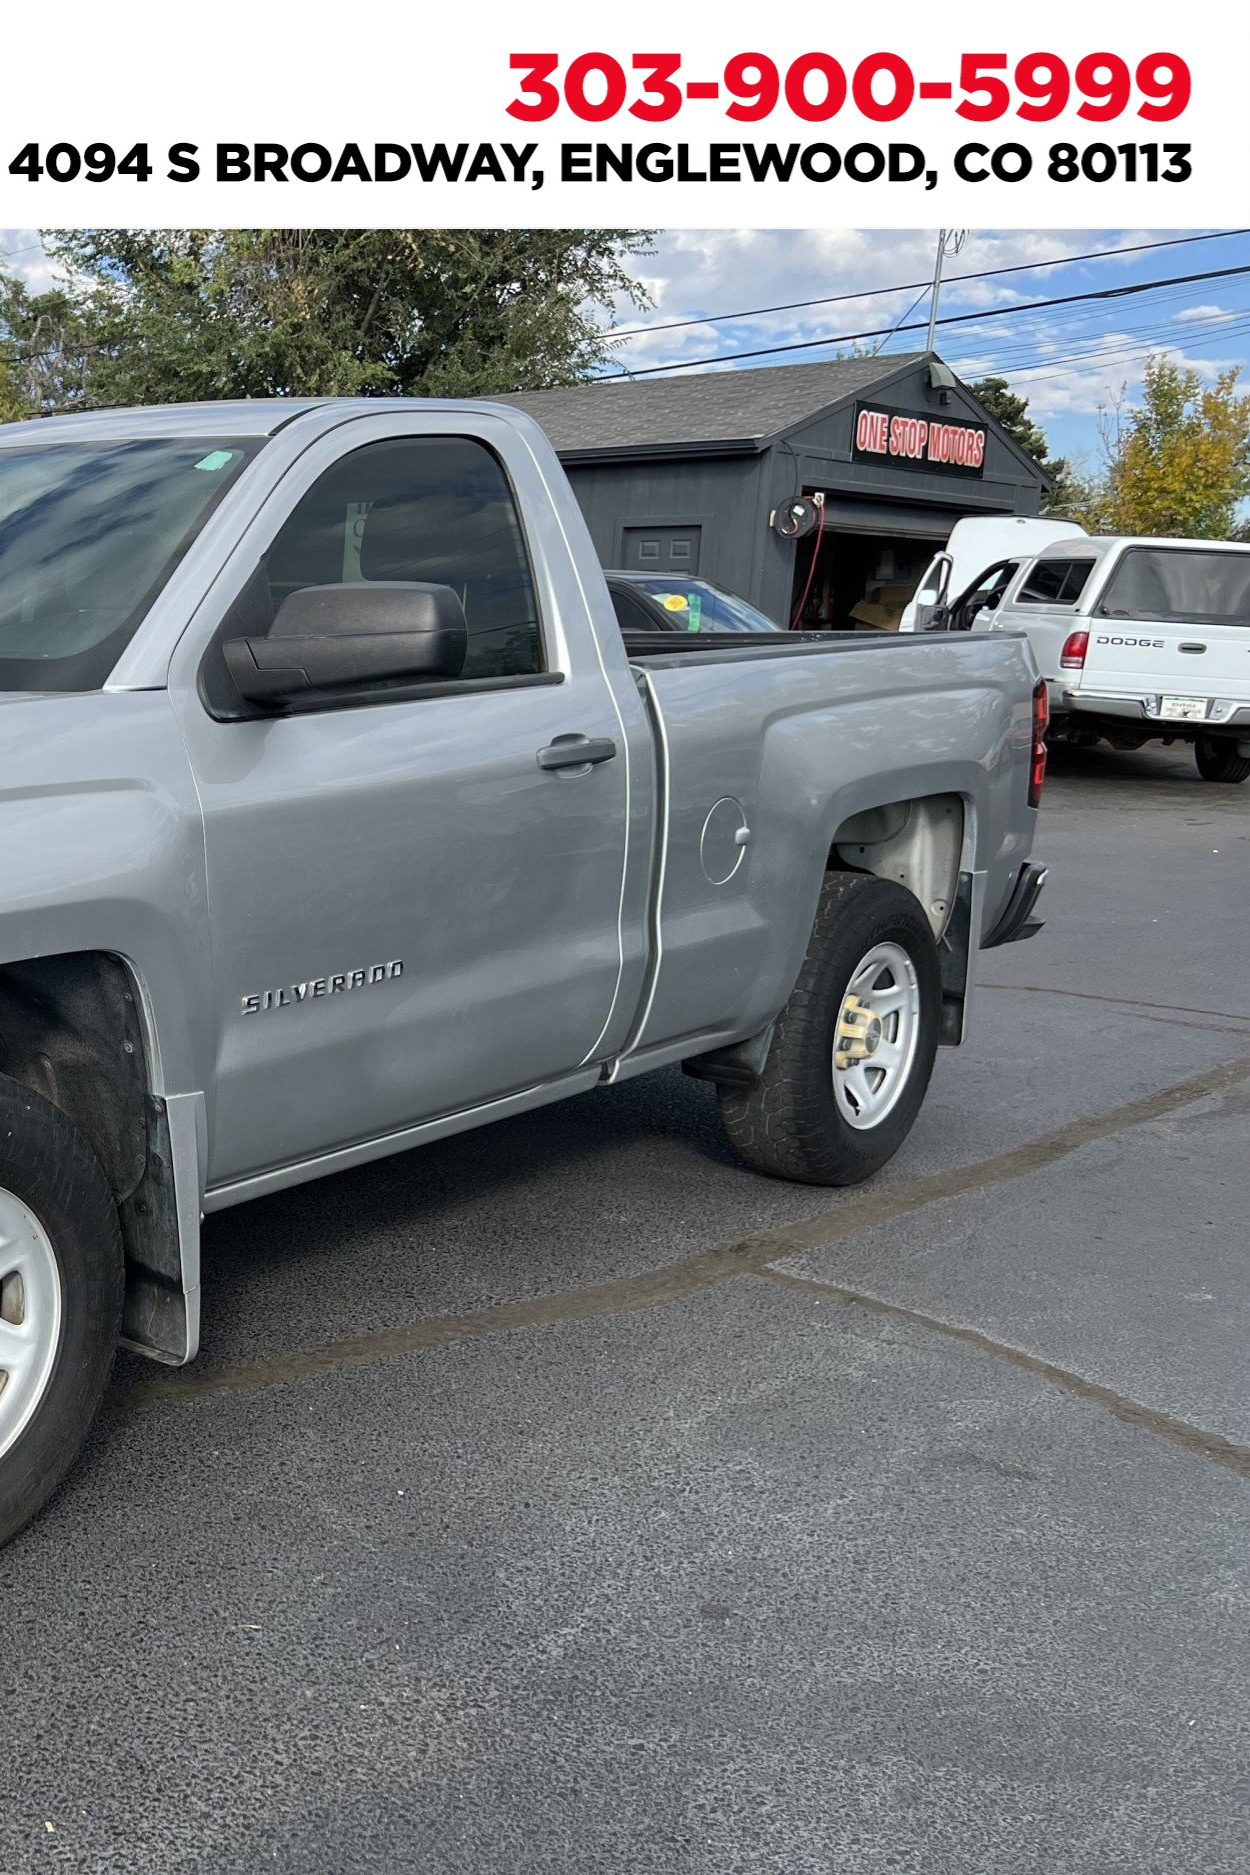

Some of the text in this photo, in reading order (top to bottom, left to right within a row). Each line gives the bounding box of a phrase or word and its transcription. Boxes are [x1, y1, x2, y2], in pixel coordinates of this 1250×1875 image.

[856, 410, 985, 468] ONE STOP MOTORS
[1096, 636, 1165, 648] DODGE
[242, 959, 404, 1015] SILVERADO
